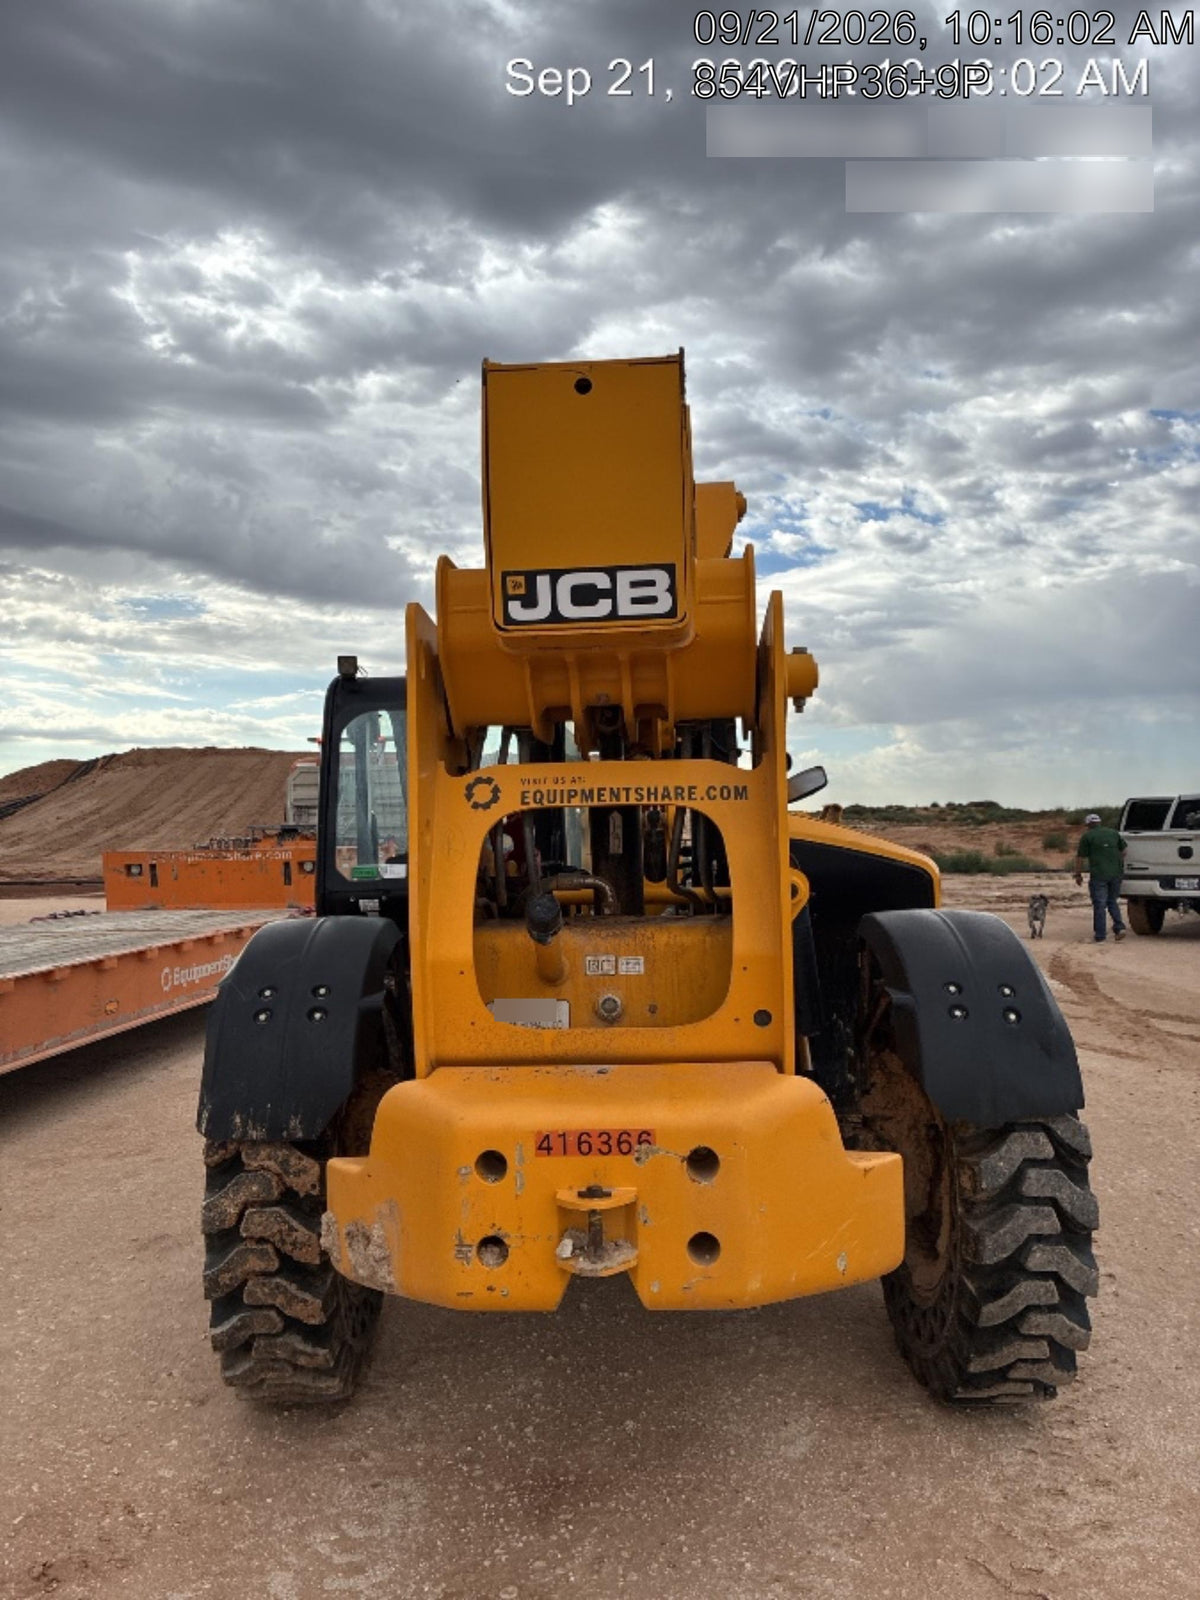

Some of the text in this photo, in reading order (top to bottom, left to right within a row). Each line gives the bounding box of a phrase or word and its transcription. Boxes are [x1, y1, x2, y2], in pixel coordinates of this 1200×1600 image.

[508, 569, 673, 621] JCB
[553, 776, 567, 785] US
[520, 785, 748, 806] EQUIPMENTSHARE.COM
[537, 1130, 652, 1156] 416366
